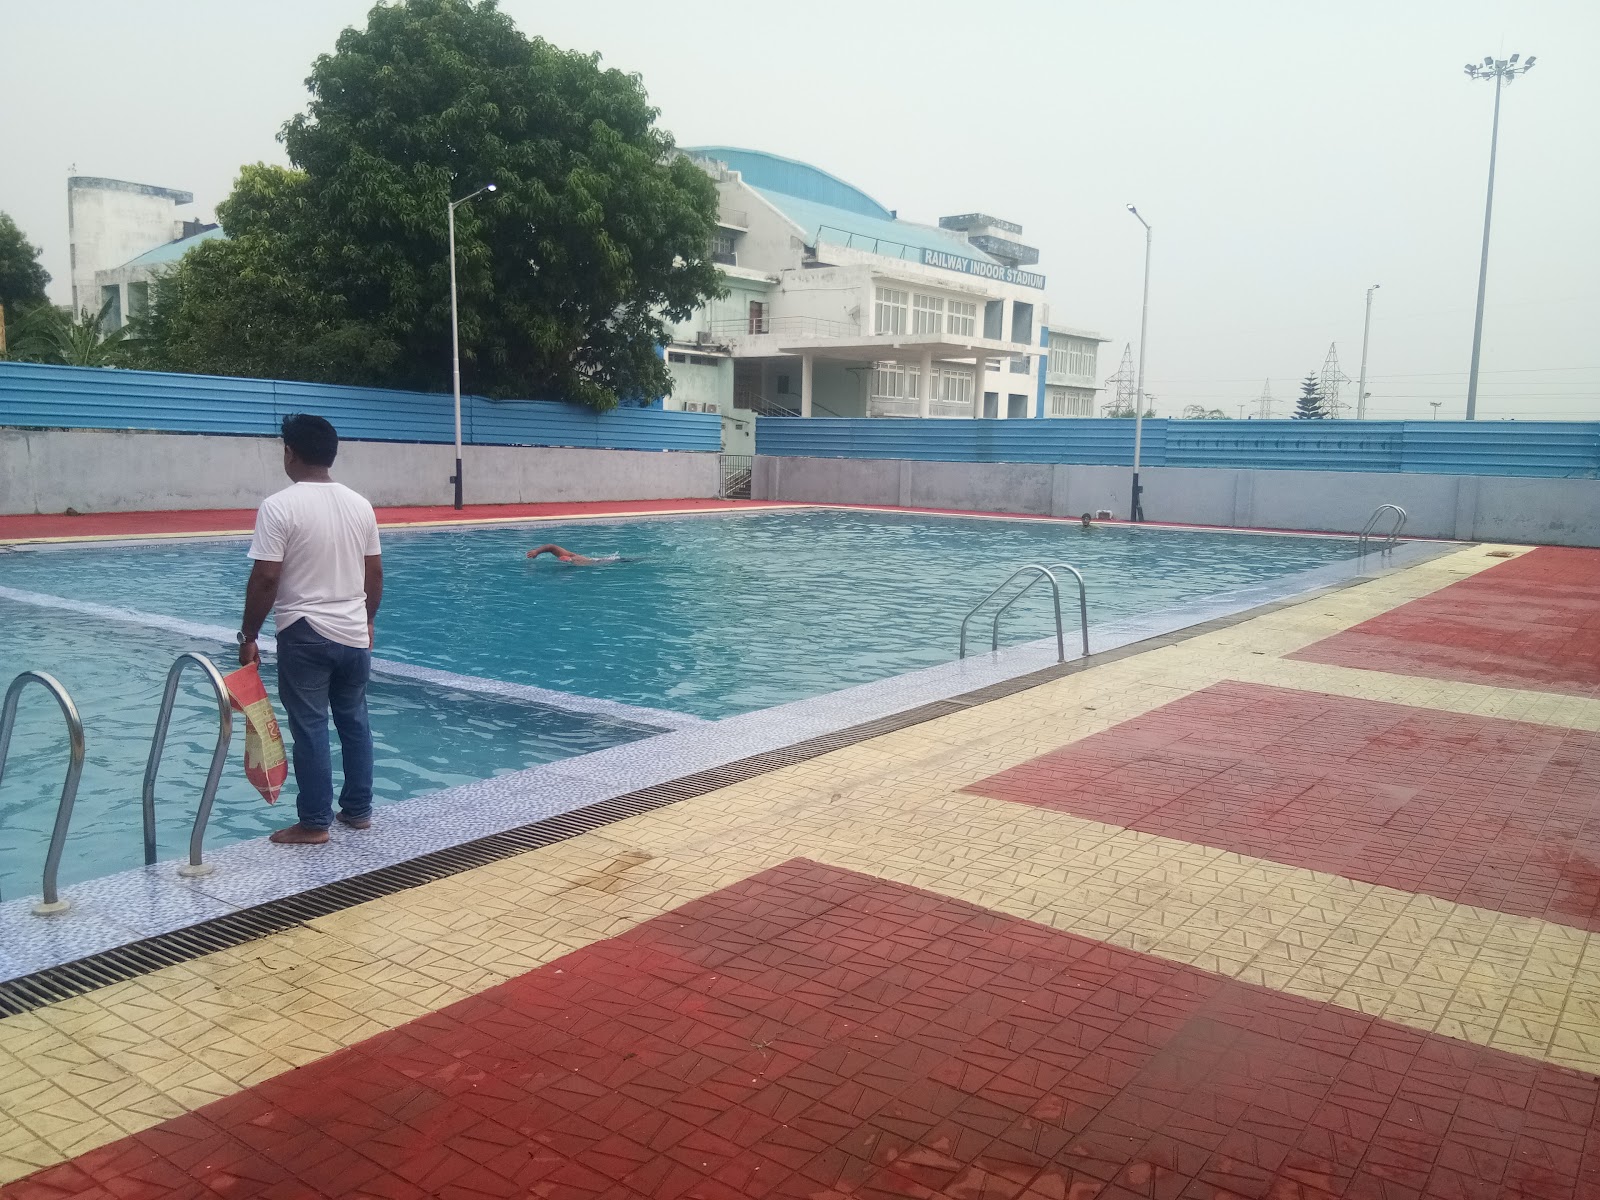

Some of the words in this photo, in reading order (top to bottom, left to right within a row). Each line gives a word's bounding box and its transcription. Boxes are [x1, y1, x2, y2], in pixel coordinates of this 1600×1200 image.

[925, 249, 969, 272] RAILWAY
[970, 261, 1006, 281] INDOOR
[1006, 269, 1044, 289] STADIUM
